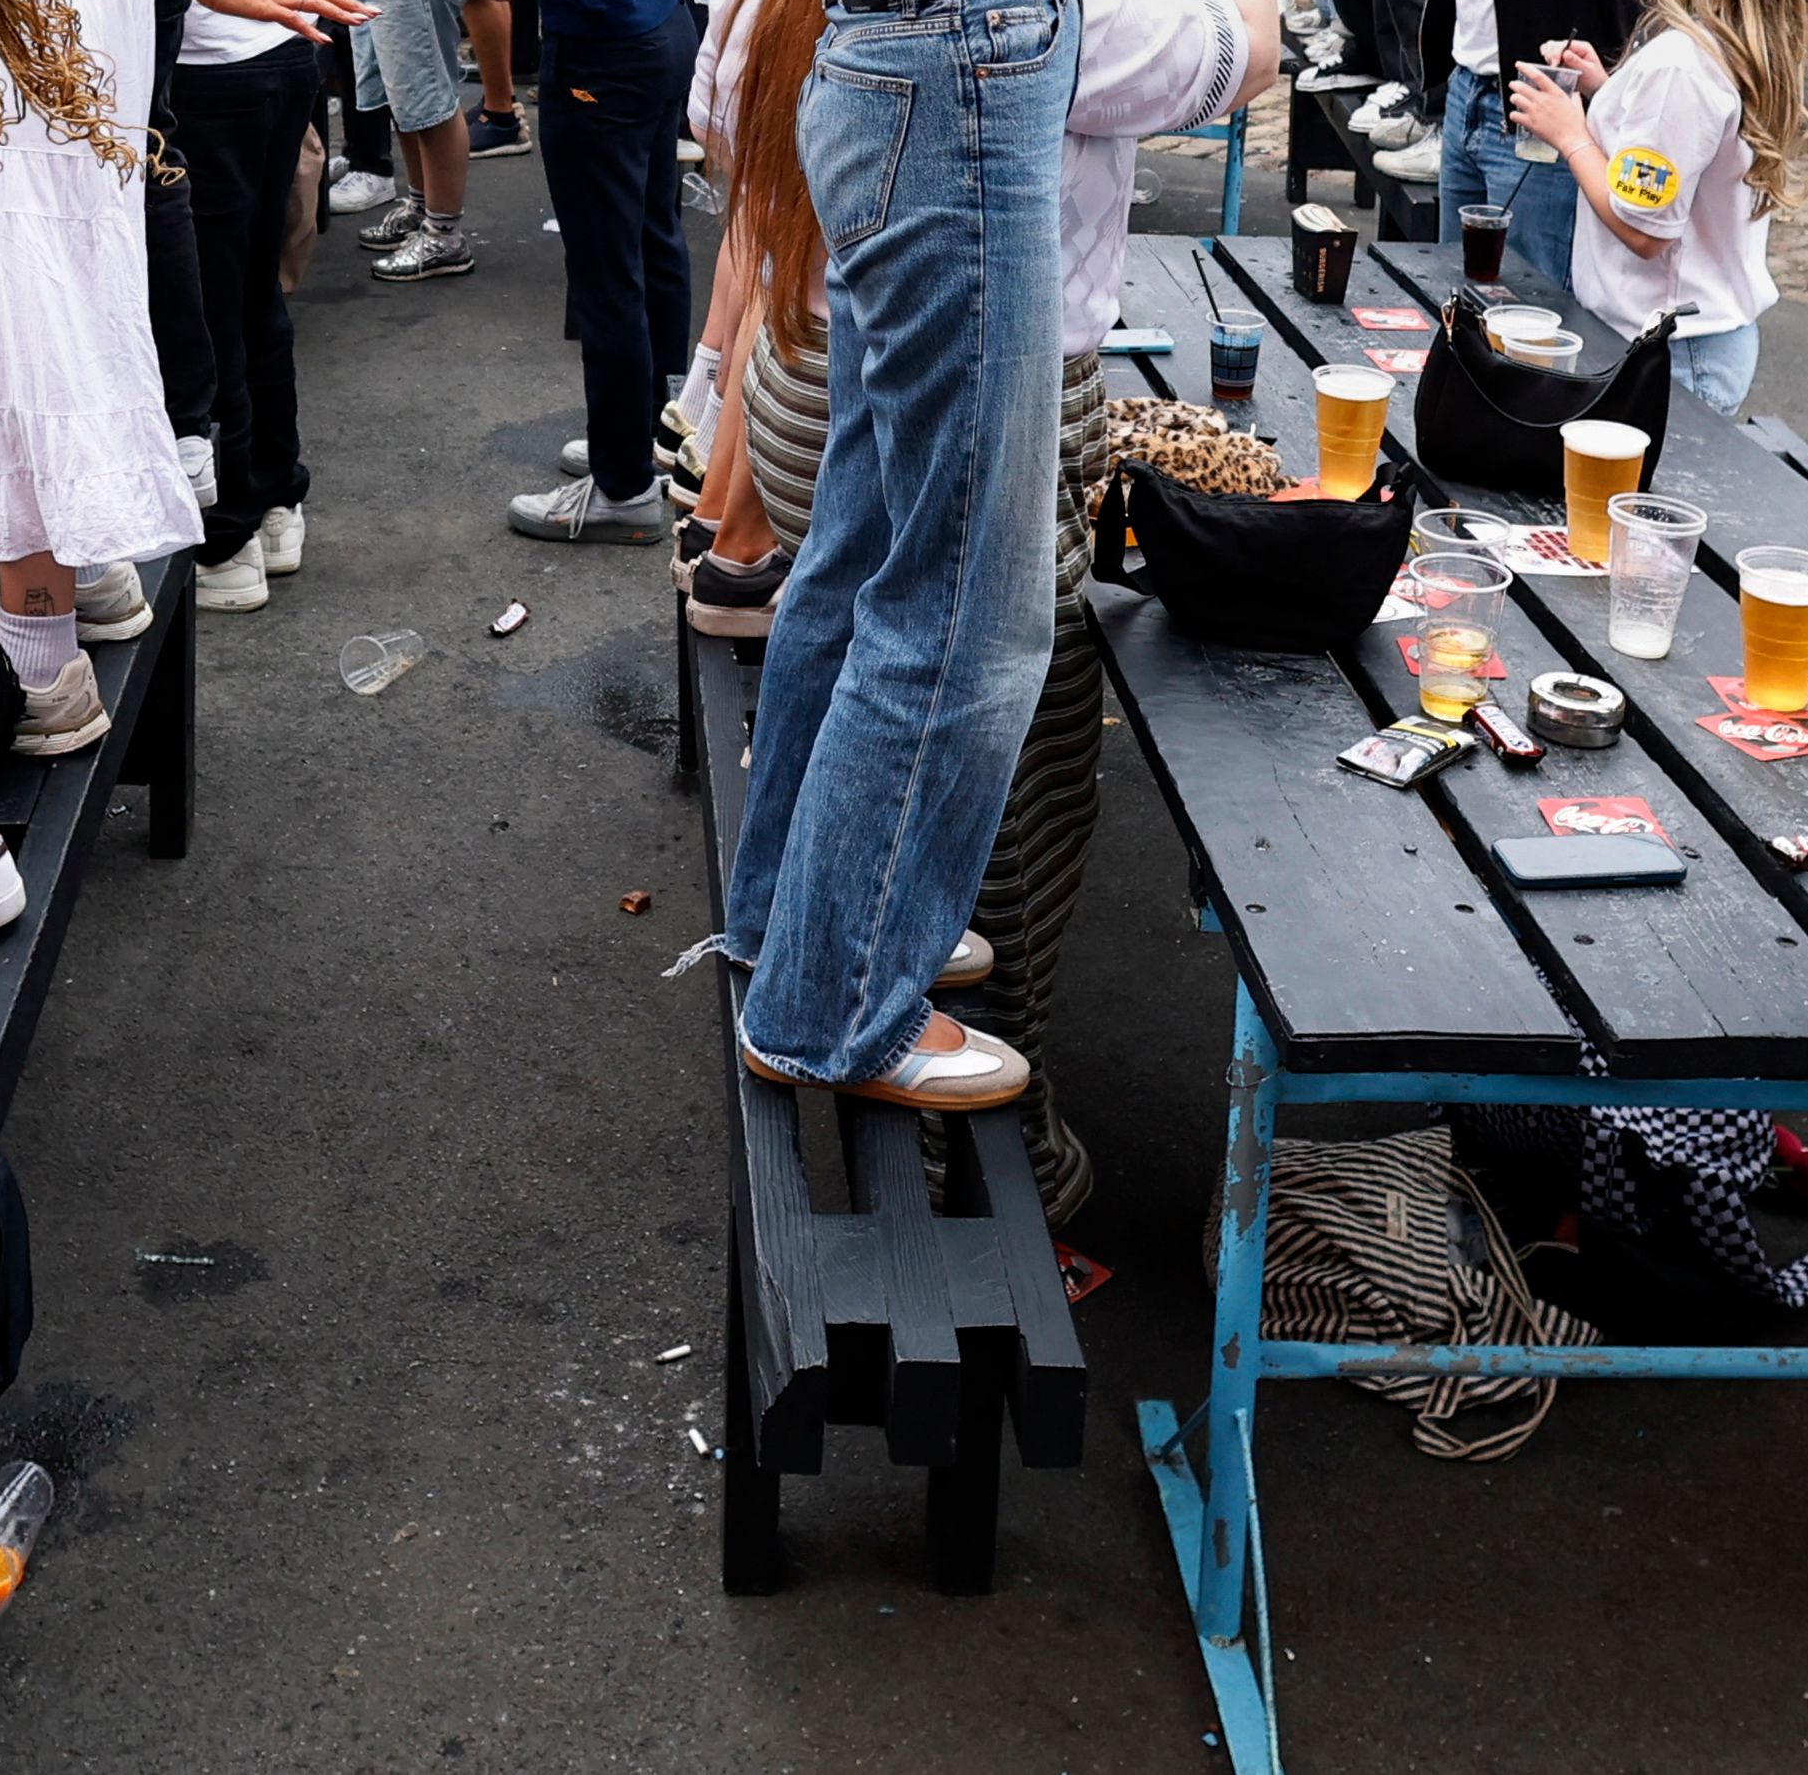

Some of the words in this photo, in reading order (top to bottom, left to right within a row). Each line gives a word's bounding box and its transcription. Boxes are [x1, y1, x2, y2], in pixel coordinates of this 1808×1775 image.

[1616, 181, 1635, 194] Fair
[1639, 190, 1663, 205] Play
[1316, 246, 1328, 294] BURGERISM
